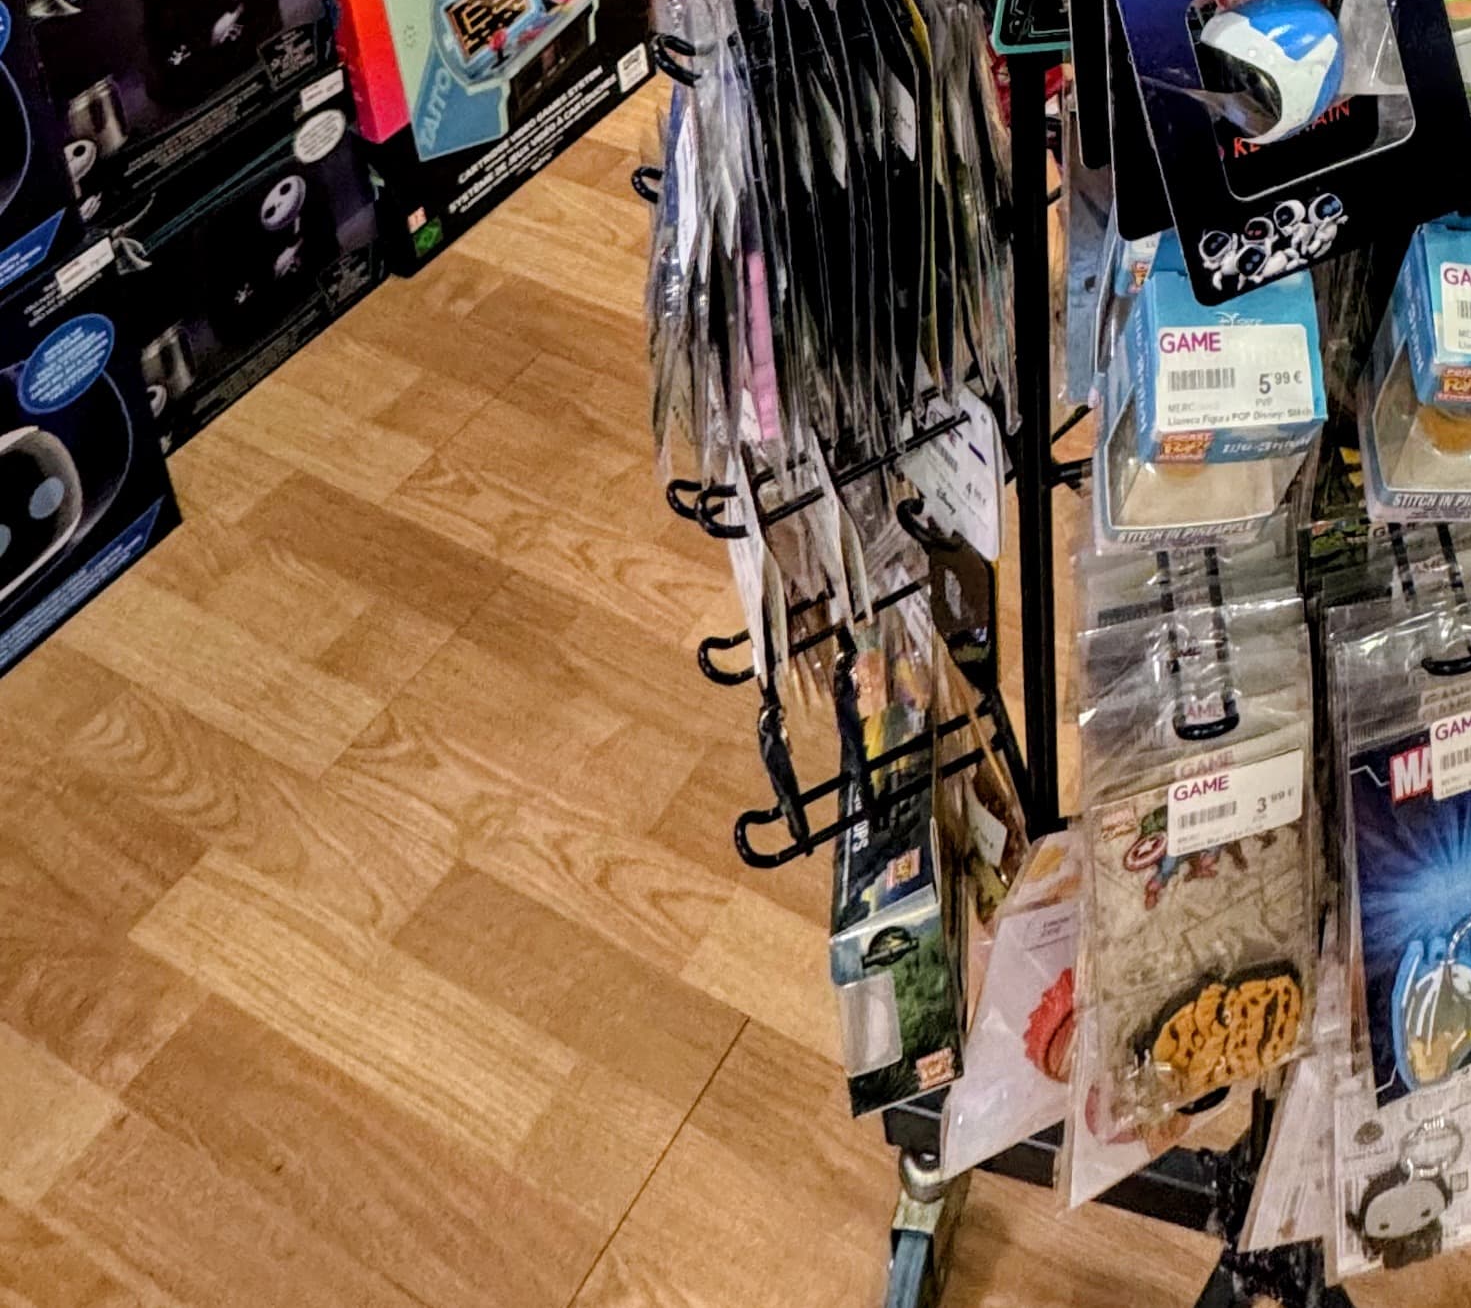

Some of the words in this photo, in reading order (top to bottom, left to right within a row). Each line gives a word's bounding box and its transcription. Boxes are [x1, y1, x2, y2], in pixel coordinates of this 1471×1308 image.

[1160, 331, 1221, 354] GAME
[1393, 493, 1441, 509] STITCH
[1441, 493, 1456, 507] IN
[1117, 525, 1162, 543] STITCH
[1183, 519, 1254, 540] PINEAPPLE
[1172, 774, 1230, 802] GAME
